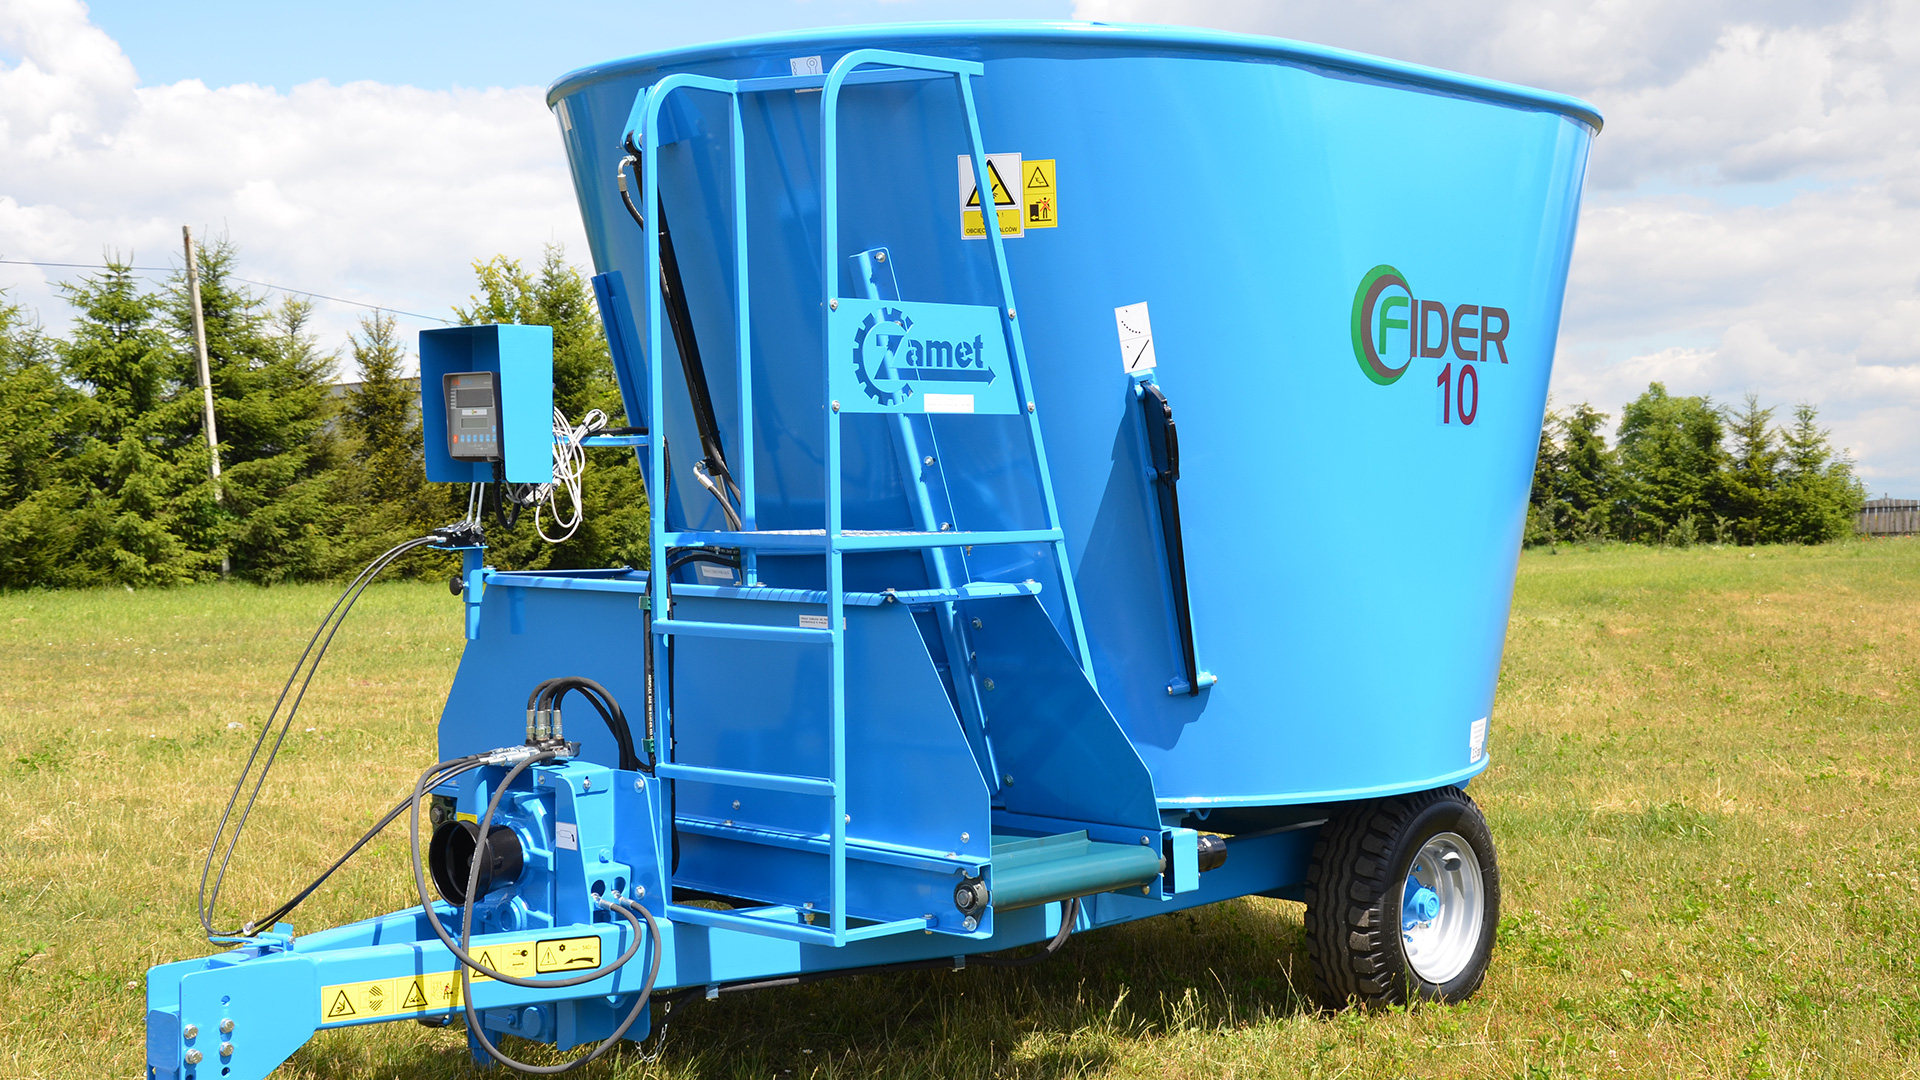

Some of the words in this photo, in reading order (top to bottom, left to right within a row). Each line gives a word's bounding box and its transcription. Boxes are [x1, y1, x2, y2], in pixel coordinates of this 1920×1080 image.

[874, 334, 984, 380] Zamet
[1379, 296, 1510, 364] FIDER
[1437, 362, 1479, 426] 10
